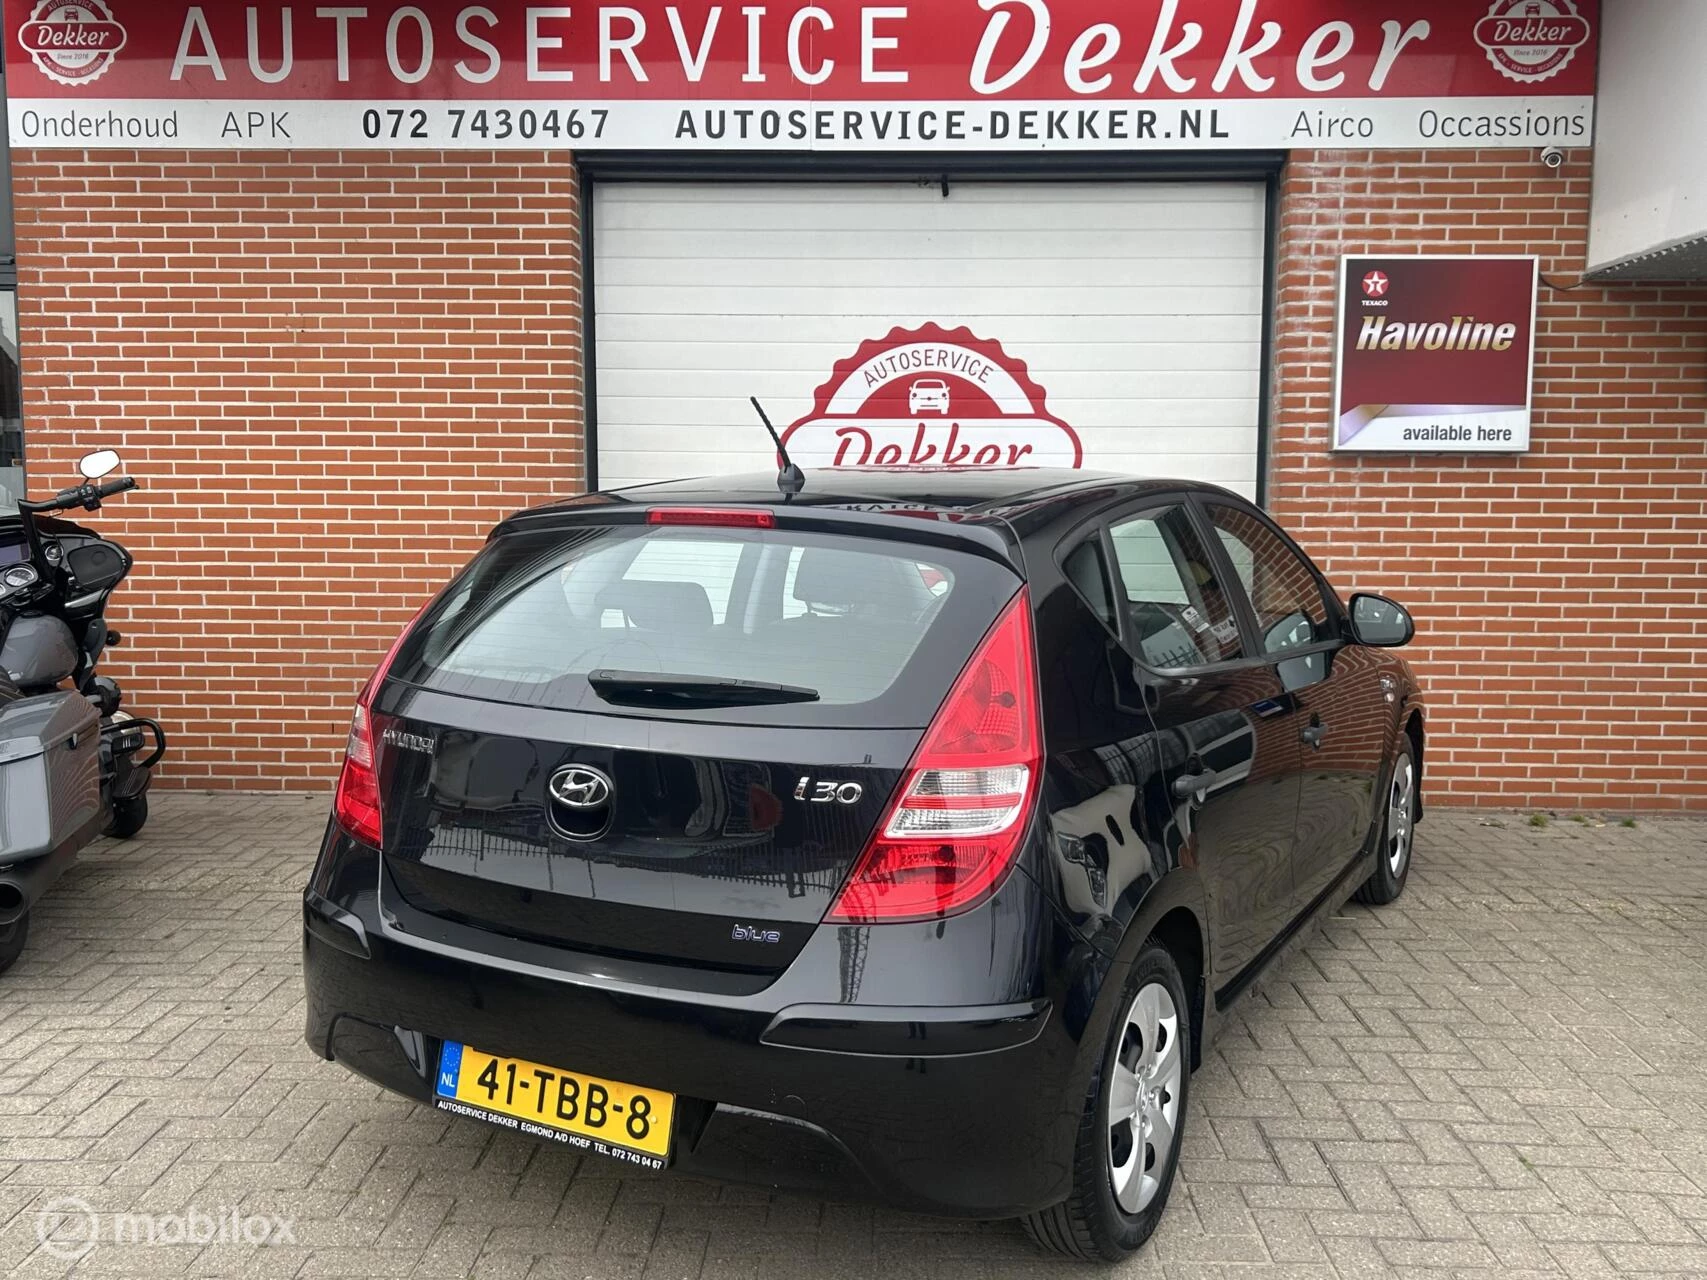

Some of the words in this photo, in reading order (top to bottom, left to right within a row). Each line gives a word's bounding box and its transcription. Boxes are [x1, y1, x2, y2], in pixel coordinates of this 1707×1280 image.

[38, 24, 109, 46] Dekker
[1493, 18, 1572, 42] Dekker
[170, 7, 909, 84] AUTOSERVICE
[970, 0, 1430, 94] Dekker
[21, 110, 178, 138] Onderhoud
[221, 111, 291, 138] APK
[362, 109, 428, 138] 072
[448, 109, 609, 138] 7430467
[676, 110, 1229, 139] AUTOSERVICE-DEKKER.NL
[1291, 110, 1374, 138] Airco
[1419, 110, 1585, 138] Occassions
[1356, 315, 1517, 351] Havoline
[863, 348, 994, 388] AUTOSERVICE
[1403, 426, 1472, 441] available
[1477, 426, 1512, 441] here
[382, 729, 435, 753] HYUNDAI
[732, 924, 781, 944] blue
[440, 1071, 456, 1089] NL
[477, 1058, 652, 1140] 41-TBB-8
[438, 1100, 487, 1121] AUTOSERVICE
[488, 1113, 518, 1129] DEKKER
[520, 1122, 554, 1139] EGMOND
[554, 1131, 568, 1142] A/D
[569, 1136, 591, 1149] HOEF
[594, 1142, 610, 1155] TEL.
[612, 1147, 625, 1159] 072
[627, 1152, 640, 1164] 743
[641, 1157, 651, 1167] 04
[652, 1160, 662, 1170] 67
